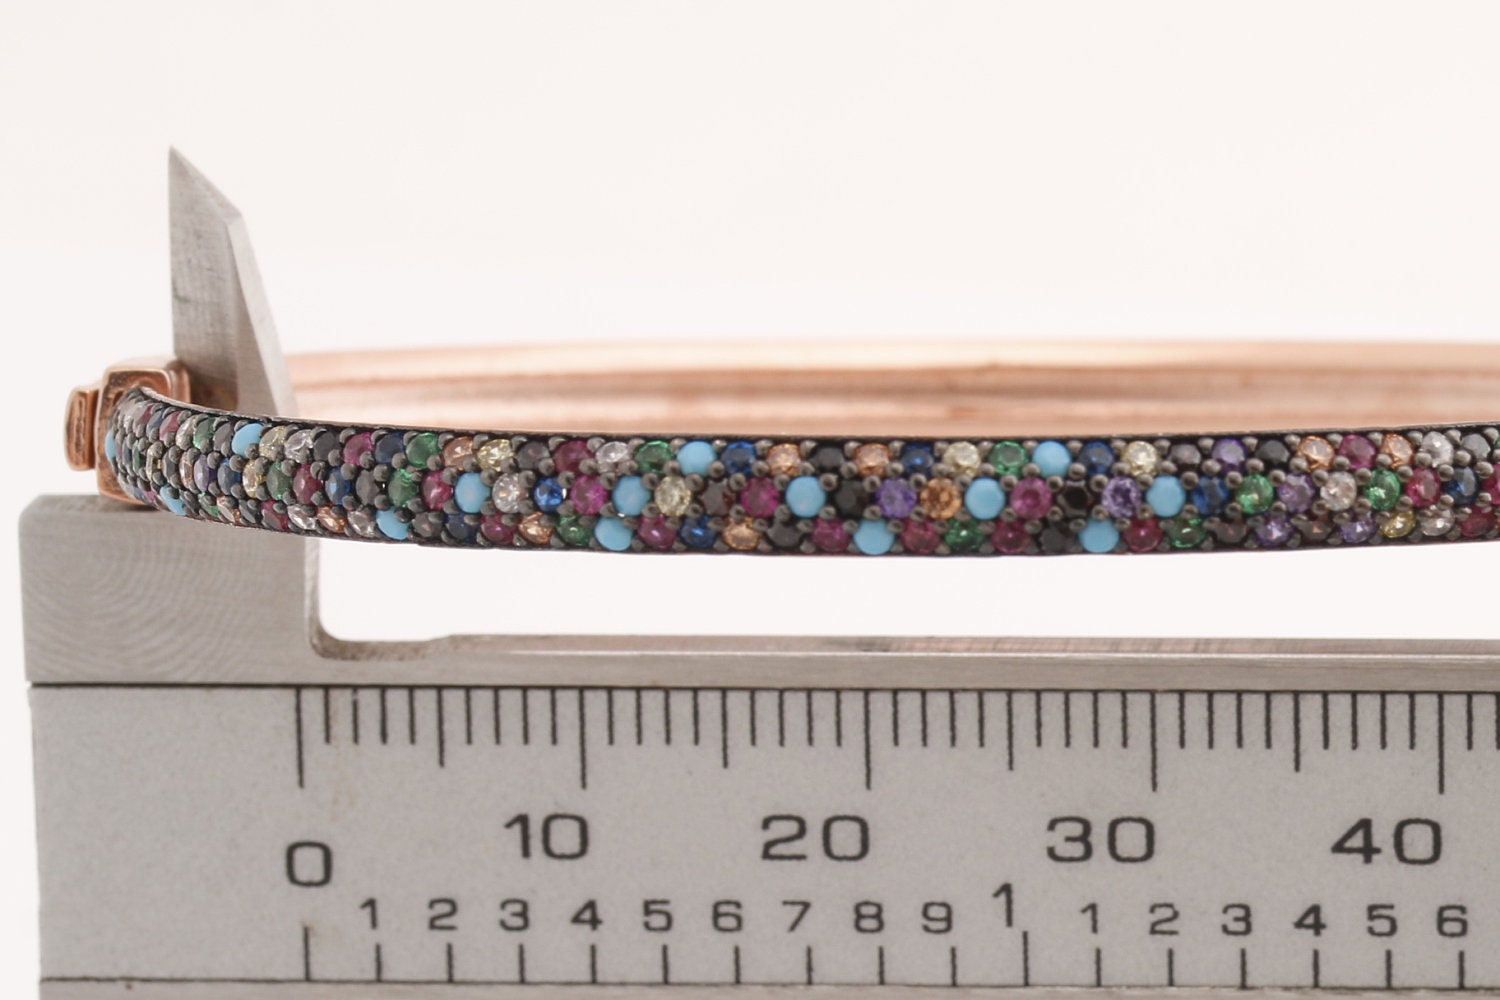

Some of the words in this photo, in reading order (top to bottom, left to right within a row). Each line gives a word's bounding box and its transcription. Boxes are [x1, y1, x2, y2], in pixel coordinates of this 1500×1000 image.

[285, 840, 334, 888] 0
[504, 812, 590, 861] 10
[760, 814, 870, 862] 20
[1046, 815, 1156, 864] 30
[1330, 817, 1443, 866] 40
[360, 897, 378, 930] 1
[428, 897, 458, 931] 2
[499, 898, 530, 932] 3
[570, 899, 603, 932] 4
[642, 899, 674, 933] 5
[711, 899, 743, 933] 6
[782, 900, 812, 933] 7
[853, 900, 885, 934] 8
[921, 901, 953, 935] 9
[992, 882, 1014, 928] 1
[1080, 902, 1099, 935] 1
[1148, 902, 1180, 936] 2
[1221, 903, 1253, 937] 3
[1293, 903, 1327, 937] 4
[1366, 903, 1398, 938] 5
[1436, 904, 1469, 939] 6
